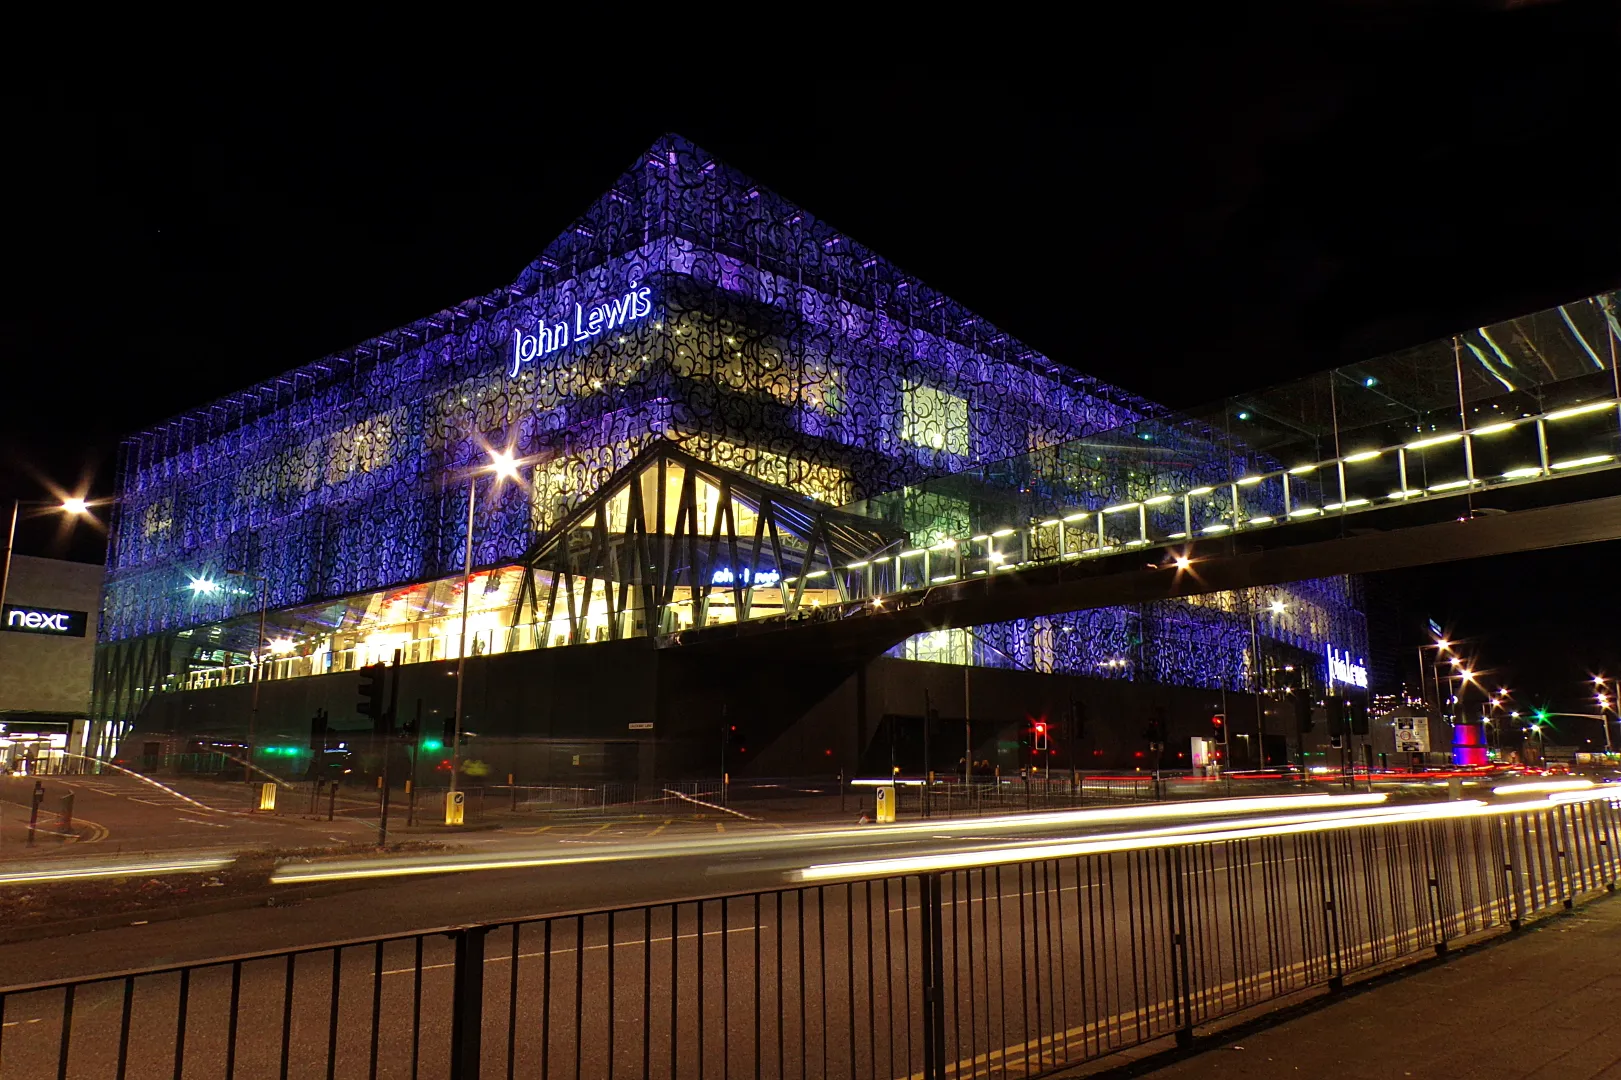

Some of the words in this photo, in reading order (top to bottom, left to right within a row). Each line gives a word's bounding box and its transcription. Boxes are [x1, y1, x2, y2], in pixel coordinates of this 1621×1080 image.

[509, 319, 569, 378] John
[573, 280, 651, 342] Lewis
[8, 610, 69, 631] next
